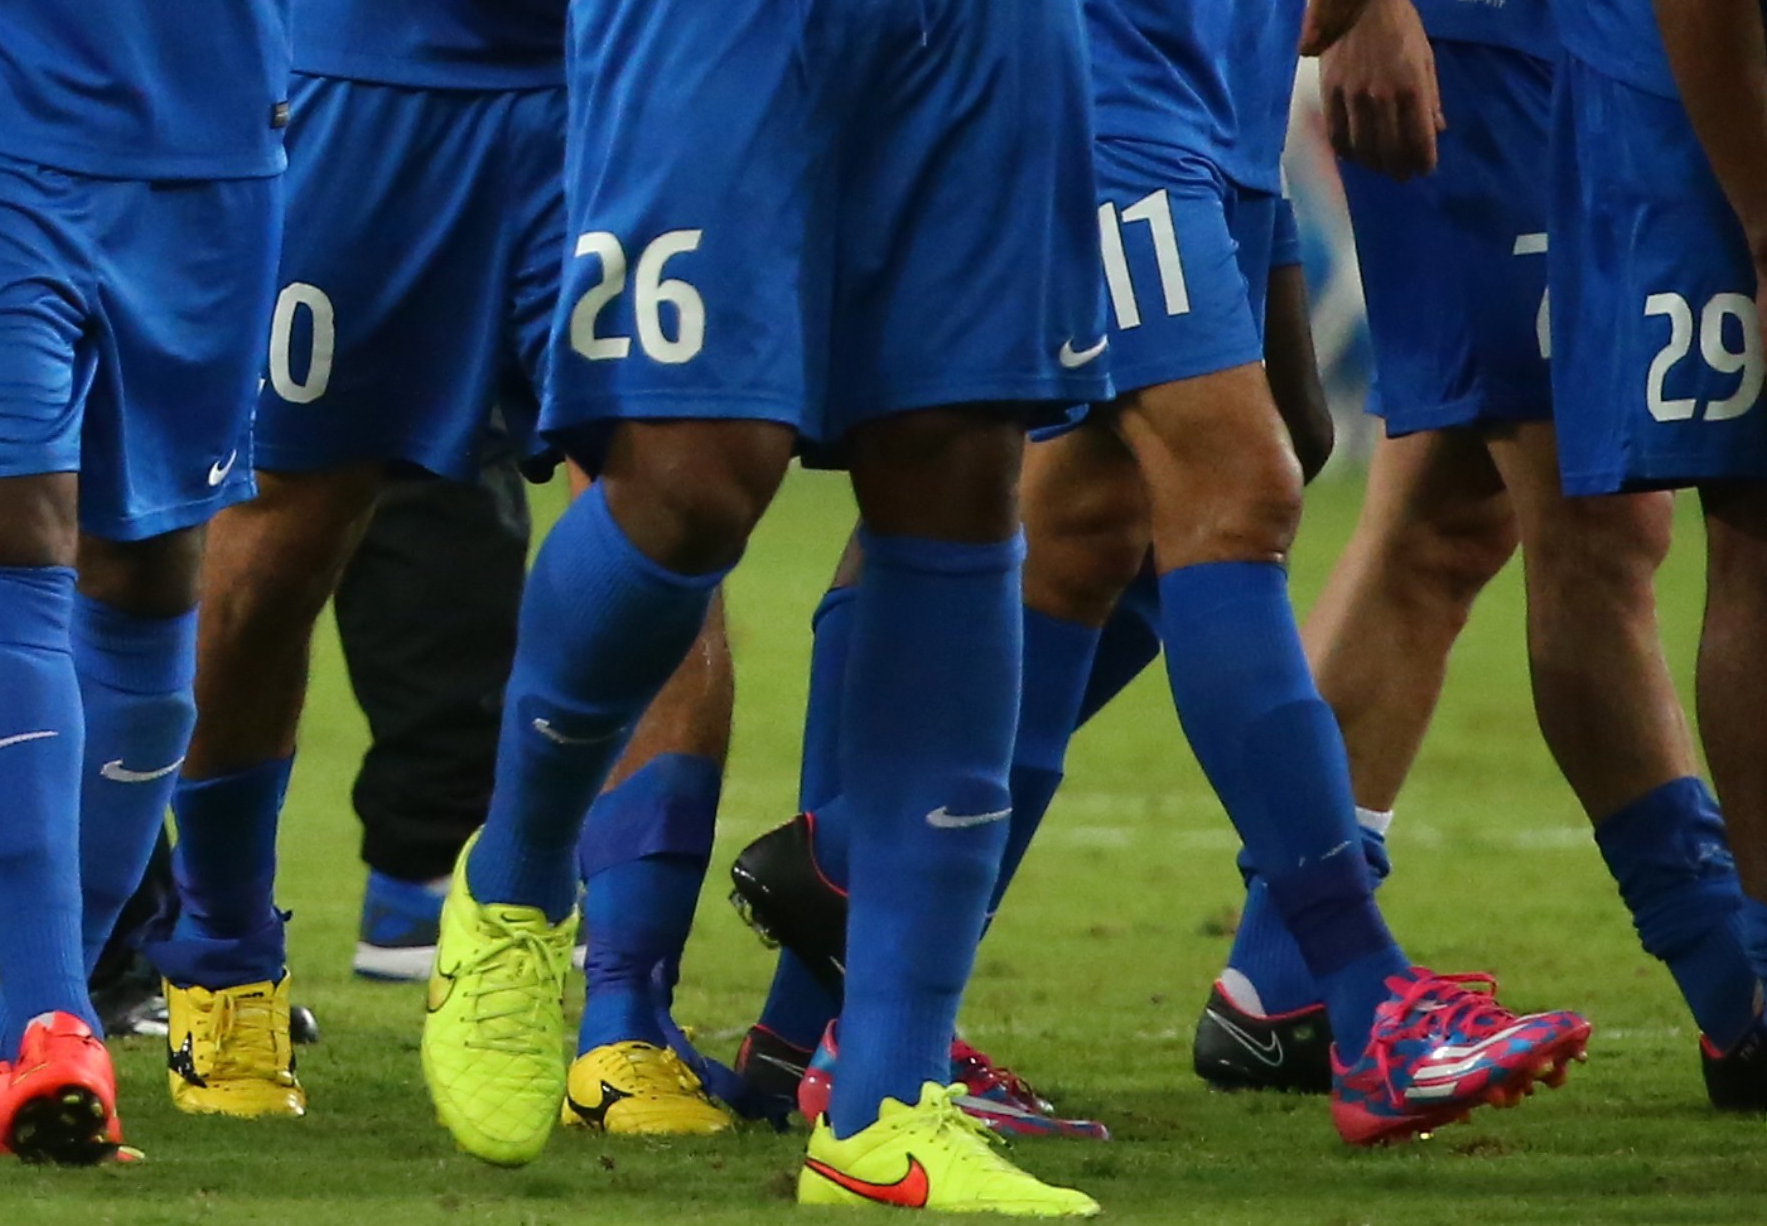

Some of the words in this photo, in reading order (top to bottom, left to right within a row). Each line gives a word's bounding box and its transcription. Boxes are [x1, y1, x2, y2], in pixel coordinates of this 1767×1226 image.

[570, 229, 705, 364] 26
[1098, 188, 1190, 329] 11
[267, 281, 335, 404] 0
[1643, 292, 1766, 423] 29
